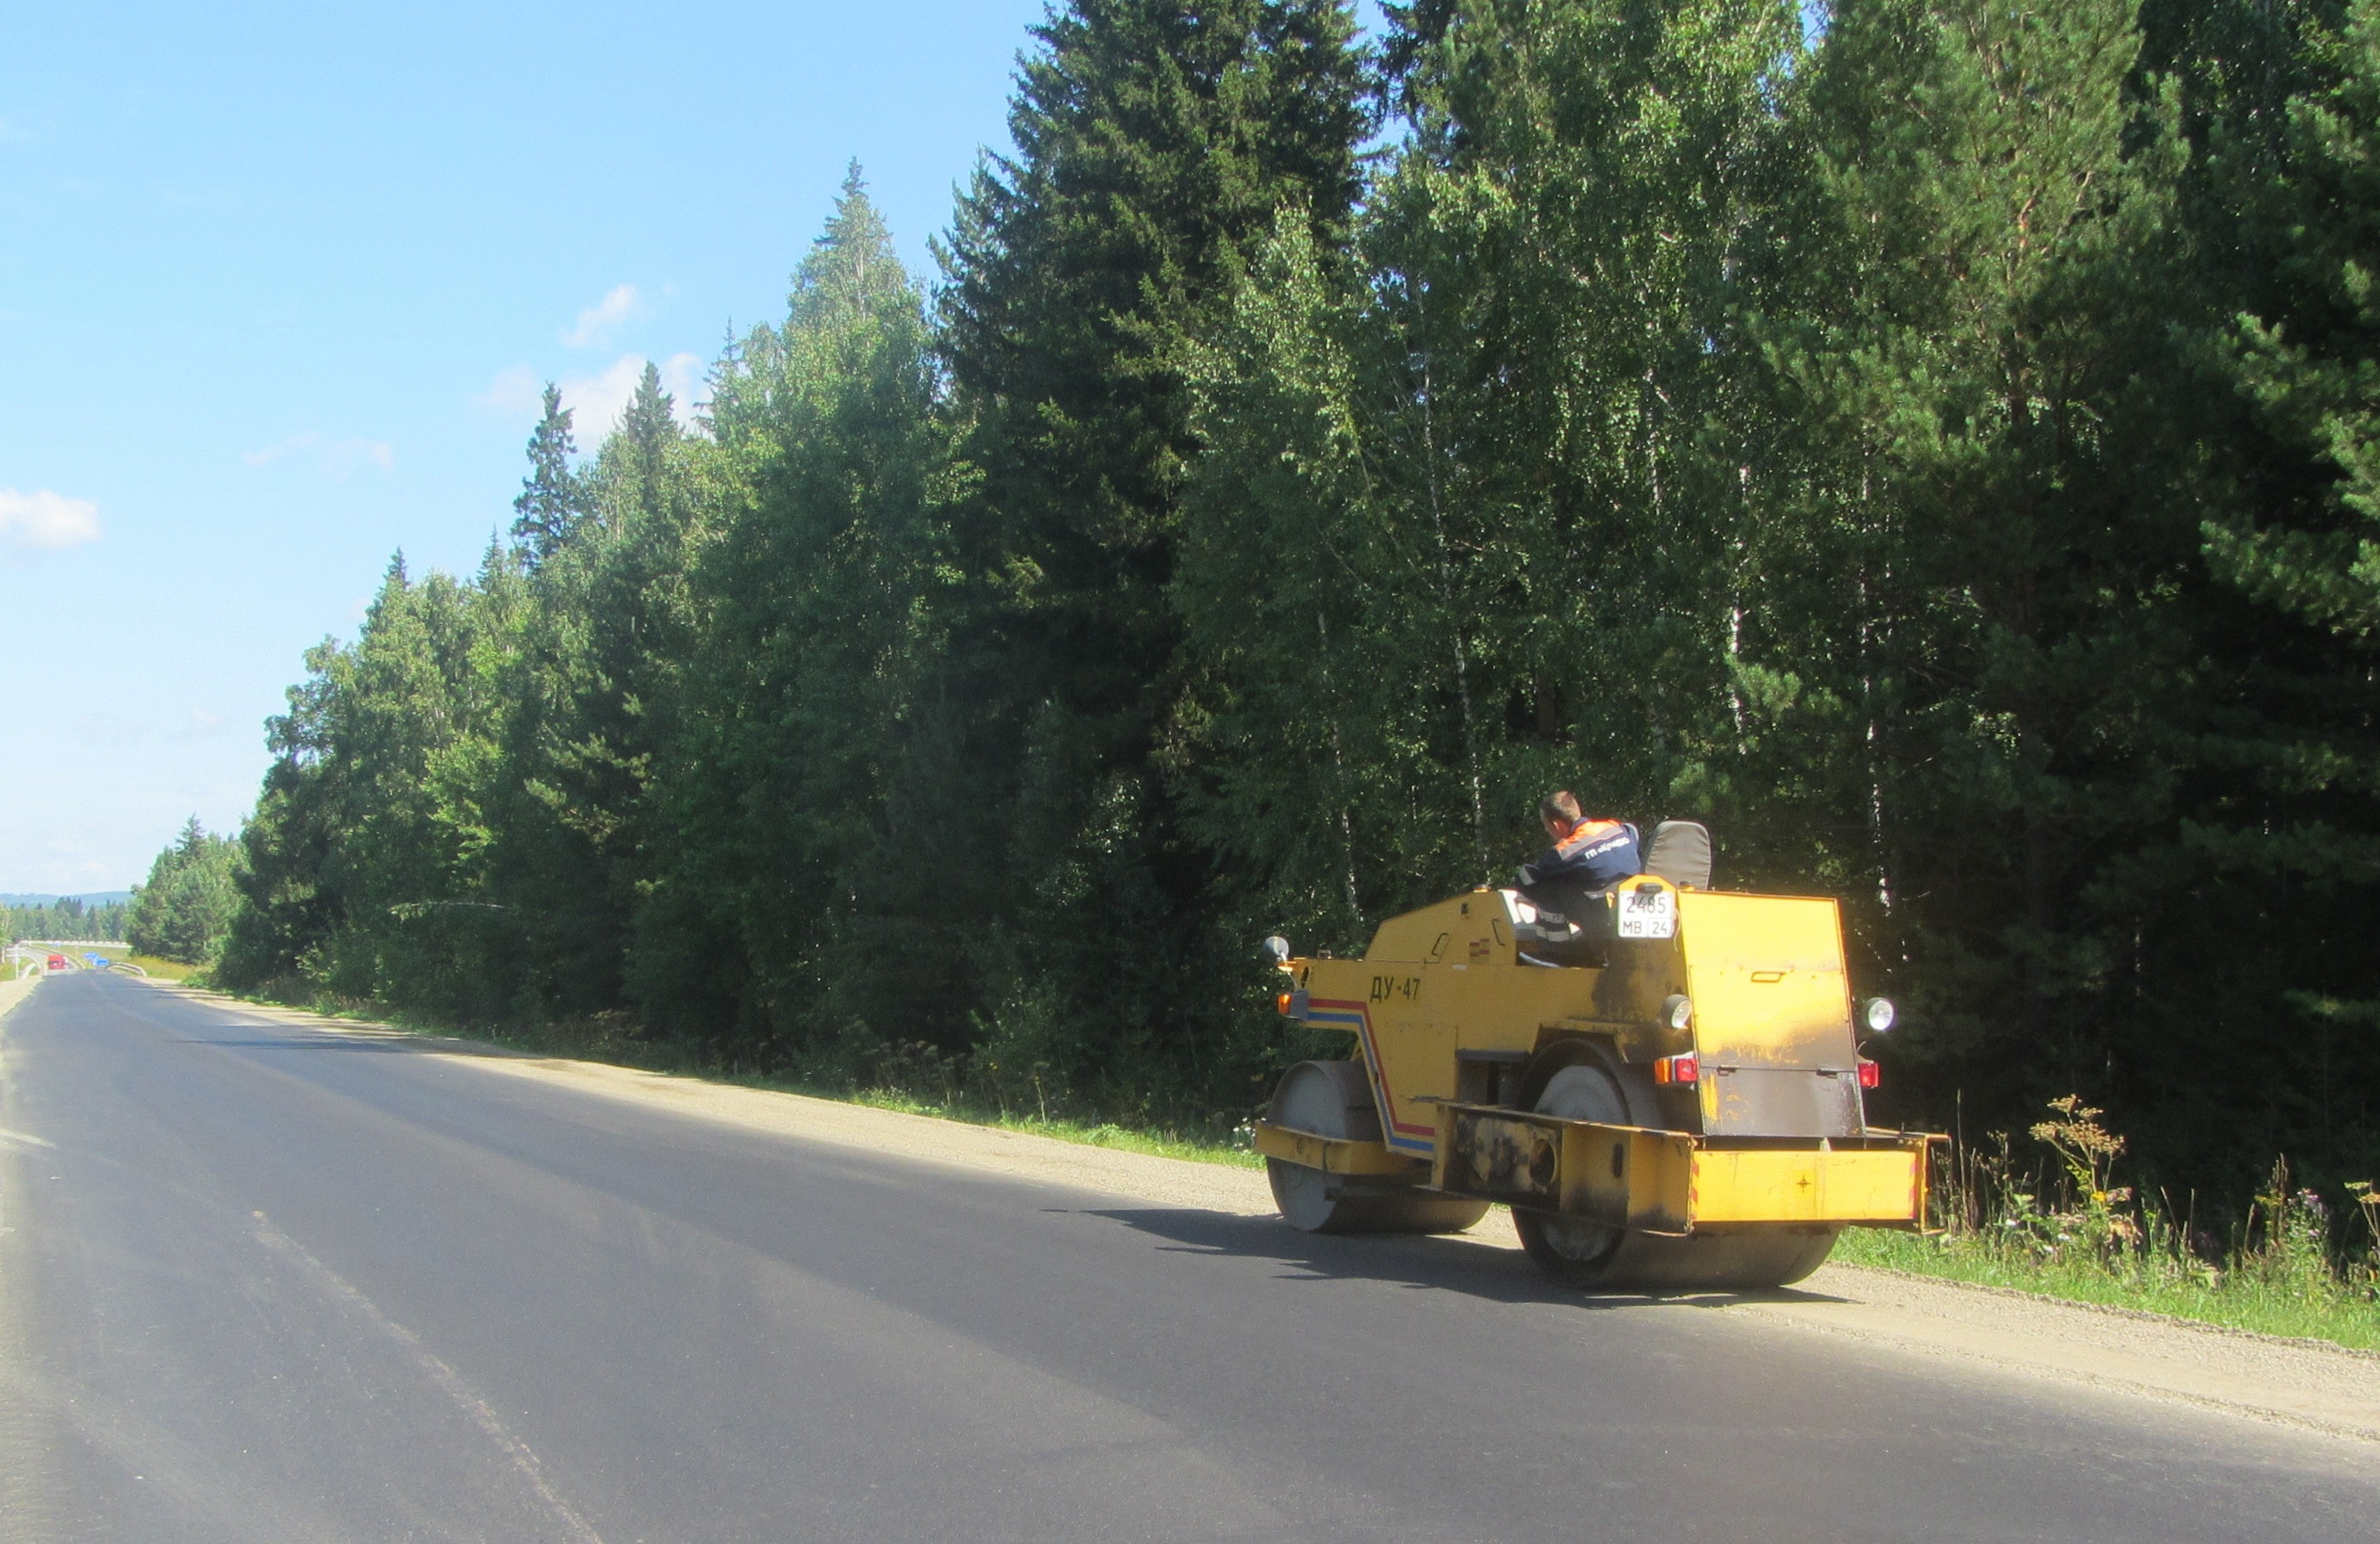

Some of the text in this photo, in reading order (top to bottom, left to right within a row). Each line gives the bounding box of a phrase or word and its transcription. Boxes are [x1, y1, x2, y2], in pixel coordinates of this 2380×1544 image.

[1626, 896, 1666, 914] 2485
[1622, 920, 1667, 934] МВ 24
[1370, 976, 1421, 1003] ДУ-47
